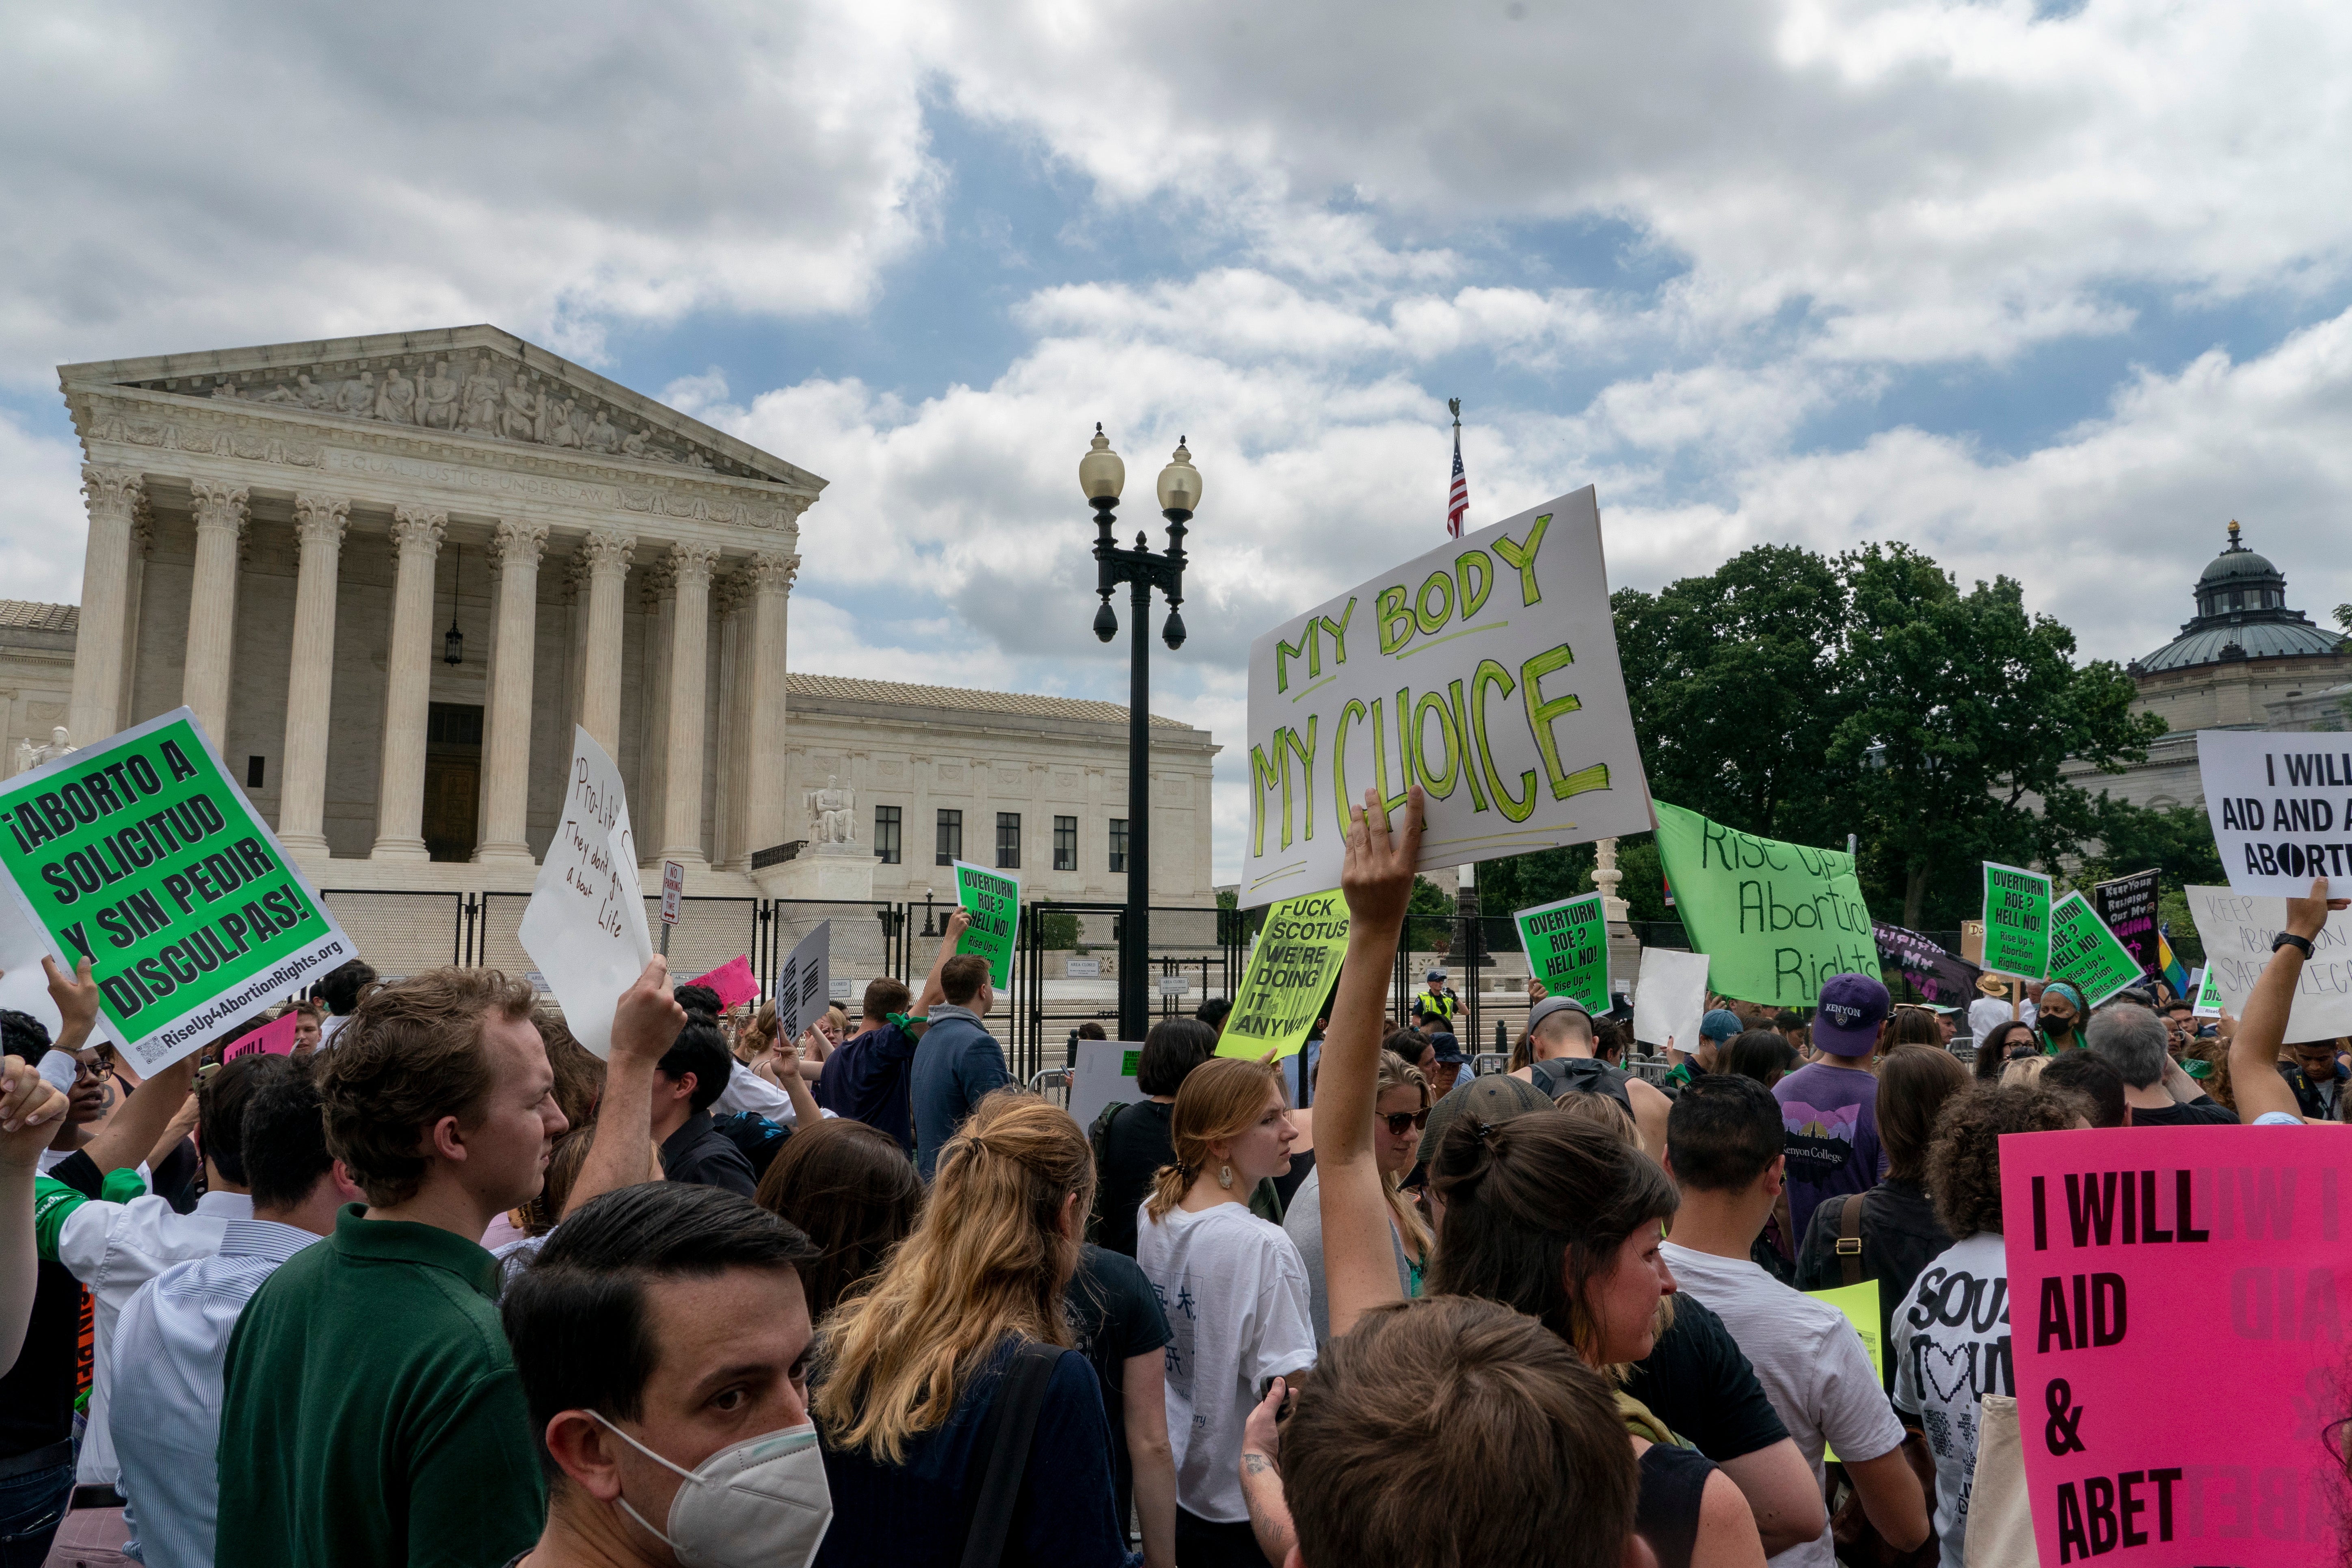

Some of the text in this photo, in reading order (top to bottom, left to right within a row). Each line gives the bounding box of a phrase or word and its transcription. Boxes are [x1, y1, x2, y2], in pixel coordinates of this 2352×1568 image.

[341, 454, 603, 501] EQUAL JUSTICE UNDER LAW
[1276, 513, 1553, 694] MY BODY
[159, 739, 199, 783] A
[1251, 643, 1612, 857] MY CHOICE
[2266, 753, 2352, 786] I WILL
[2223, 798, 2264, 830] AID
[2273, 799, 2333, 831] AND
[41, 794, 226, 905] SOLICITUD
[566, 821, 589, 865] They
[1703, 818, 1788, 871] Rise
[665, 878, 681, 892] PARKING
[670, 867, 677, 878] NO
[964, 871, 1013, 900] OVERTURN
[1994, 871, 2044, 897] OVERTURN
[60, 837, 276, 967] Y SIN PEDIR
[666, 901, 675, 911] TIME
[667, 892, 676, 901] ANY
[977, 892, 1004, 916] ROE ?
[1280, 899, 1336, 916] FUCK
[2004, 891, 2034, 912] ROE ?
[2206, 895, 2253, 923] KEEP
[599, 898, 621, 937] Life
[970, 910, 1010, 939] HELL NO!
[1272, 919, 1349, 940] SCOTUS
[1528, 902, 1598, 936] OVERTURN
[1995, 908, 2041, 932] HELL NO!
[2052, 901, 2083, 931] TURN
[2110, 916, 2152, 938] AGINA
[98, 883, 311, 1019] DISCULPAS!
[968, 935, 998, 954] Rise Up 4
[1549, 927, 1587, 954] ROE ?
[2000, 931, 2035, 947] Rise Up 4
[2001, 944, 2033, 960] Abortion
[2050, 932, 2103, 972] HELL NO!
[730, 958, 747, 971] RIGHTS
[1266, 945, 1328, 964] WE'RE
[1546, 945, 1598, 977] HELL NO!
[1998, 957, 2036, 976] Rights.org
[1256, 969, 1319, 988] DOING
[1554, 972, 1591, 993] Rise Up 4
[2066, 966, 2087, 982] Rise
[2085, 960, 2099, 970] Up
[2077, 966, 2114, 991] Abortion
[161, 940, 344, 1048] RiseUp4AbortionRights.org
[732, 984, 757, 1001] RIGHTS
[802, 965, 818, 1007] WILL
[2084, 973, 2127, 1002] Rights.org
[1247, 992, 1271, 1010] IT
[1825, 1004, 1861, 1017] KENYON
[1234, 1013, 1313, 1037] ANYWAY
[1811, 1147, 1842, 1163] College
[2031, 1169, 2209, 1251] I WILL
[1907, 1267, 2009, 1334] SOU
[2037, 1272, 2127, 1354] AID
[2045, 1378, 2086, 1456] &
[2057, 1467, 2182, 1565] ABET
